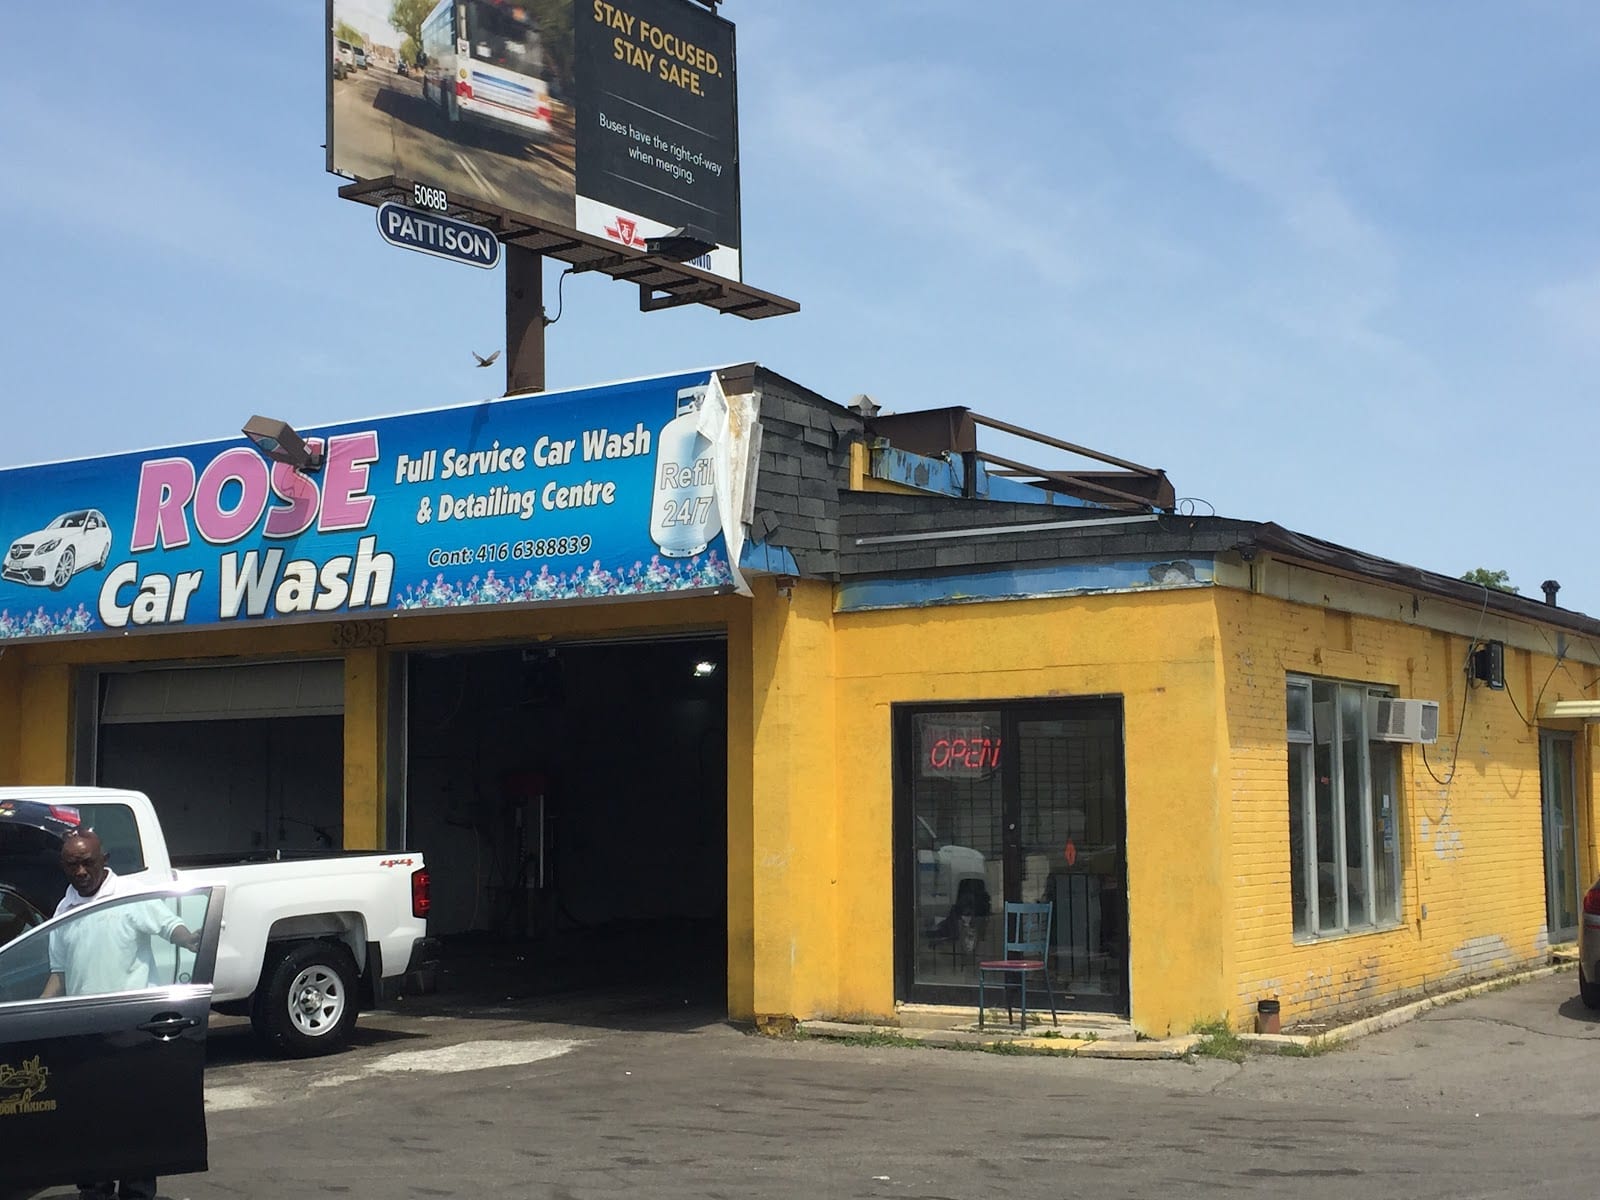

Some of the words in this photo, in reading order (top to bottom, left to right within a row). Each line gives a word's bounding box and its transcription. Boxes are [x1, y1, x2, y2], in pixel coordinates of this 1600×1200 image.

[593, 0, 635, 36] STAY
[640, 20, 722, 78] FOCUSED.
[613, 37, 655, 73] STAY
[659, 58, 705, 97] SAFE.
[599, 112, 627, 136] Buses
[629, 124, 651, 145] have
[653, 135, 668, 152] the
[670, 142, 722, 177] right-of-way
[629, 146, 653, 166] when
[655, 157, 695, 184] merging.
[414, 184, 447, 211] 5068B
[388, 211, 490, 260] PATTISON
[395, 450, 436, 484] Full
[441, 440, 526, 480] Service
[533, 436, 576, 467] Car
[582, 422, 651, 462] Wash
[130, 430, 380, 553] ROSE
[416, 496, 432, 524] &
[437, 485, 536, 522] Detailing
[541, 480, 617, 511] Centre
[661, 496, 713, 528] 24/7
[428, 549, 473, 568] Cont:
[475, 545, 508, 563] 416
[511, 535, 592, 560] 6388839
[98, 561, 203, 628] Car
[219, 536, 395, 619] Wash
[931, 738, 1002, 768] OPEN
